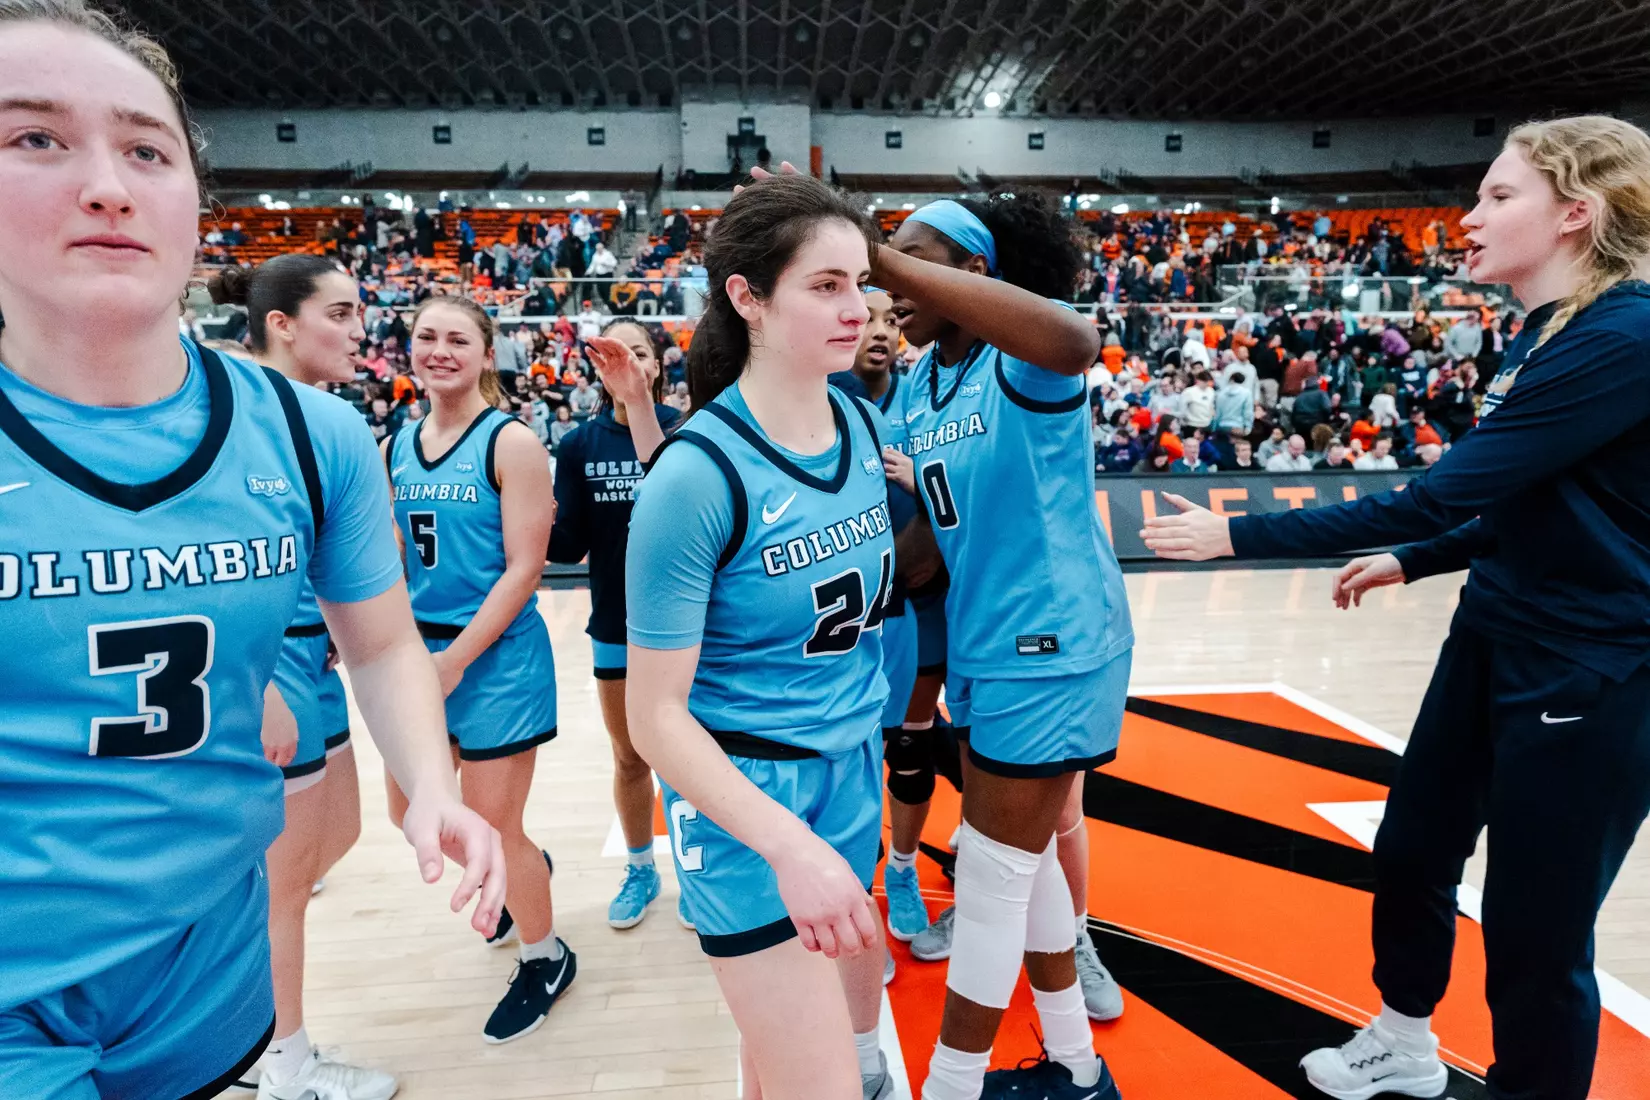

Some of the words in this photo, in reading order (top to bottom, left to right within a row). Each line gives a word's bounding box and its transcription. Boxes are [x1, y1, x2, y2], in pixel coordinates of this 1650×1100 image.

[250, 478, 274, 493] Ivy
[594, 491, 635, 502] BASKE
[605, 479, 642, 490] WOM
[921, 459, 960, 531] 0
[407, 511, 438, 570] 5
[763, 502, 892, 577] COLUMBI
[803, 547, 894, 658] 24
[1042, 640, 1055, 649] XL
[87, 614, 216, 760] 3
[670, 799, 704, 872] C
